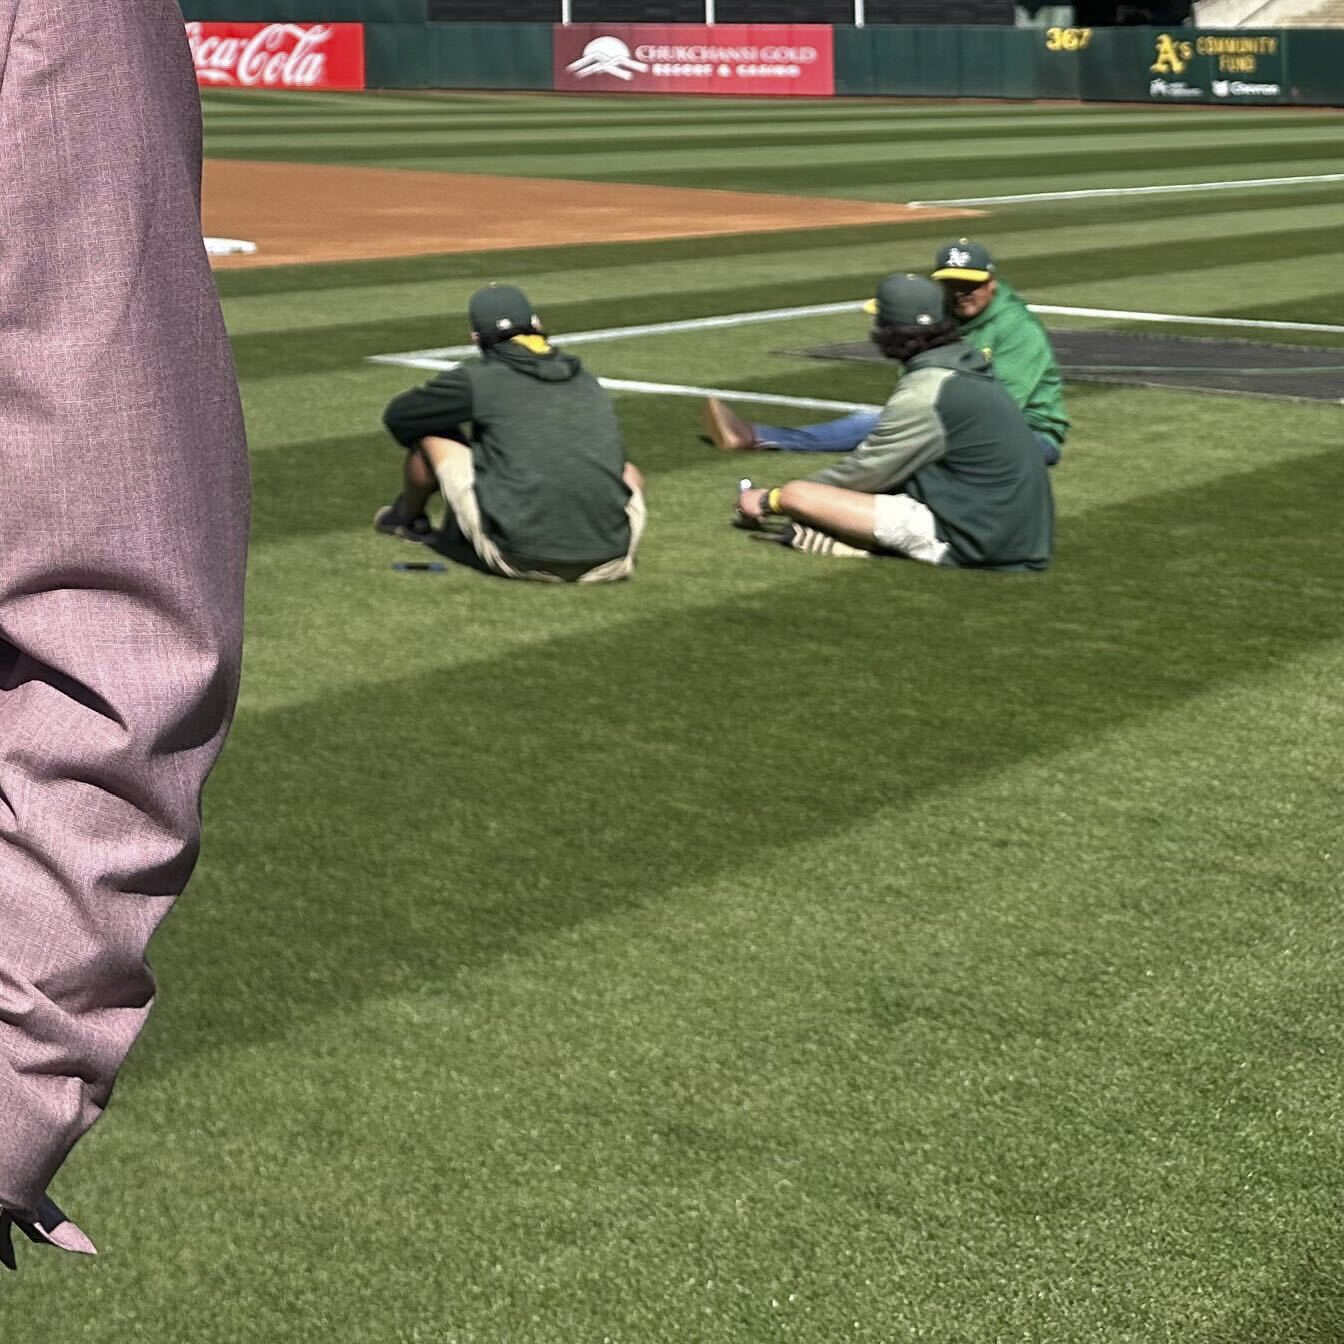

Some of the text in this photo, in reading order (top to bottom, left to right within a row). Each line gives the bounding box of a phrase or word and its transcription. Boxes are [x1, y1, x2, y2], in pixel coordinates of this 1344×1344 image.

[1046, 27, 1092, 51] 367
[1197, 36, 1278, 56] COMMUNITY
[760, 45, 817, 64] GOLD
